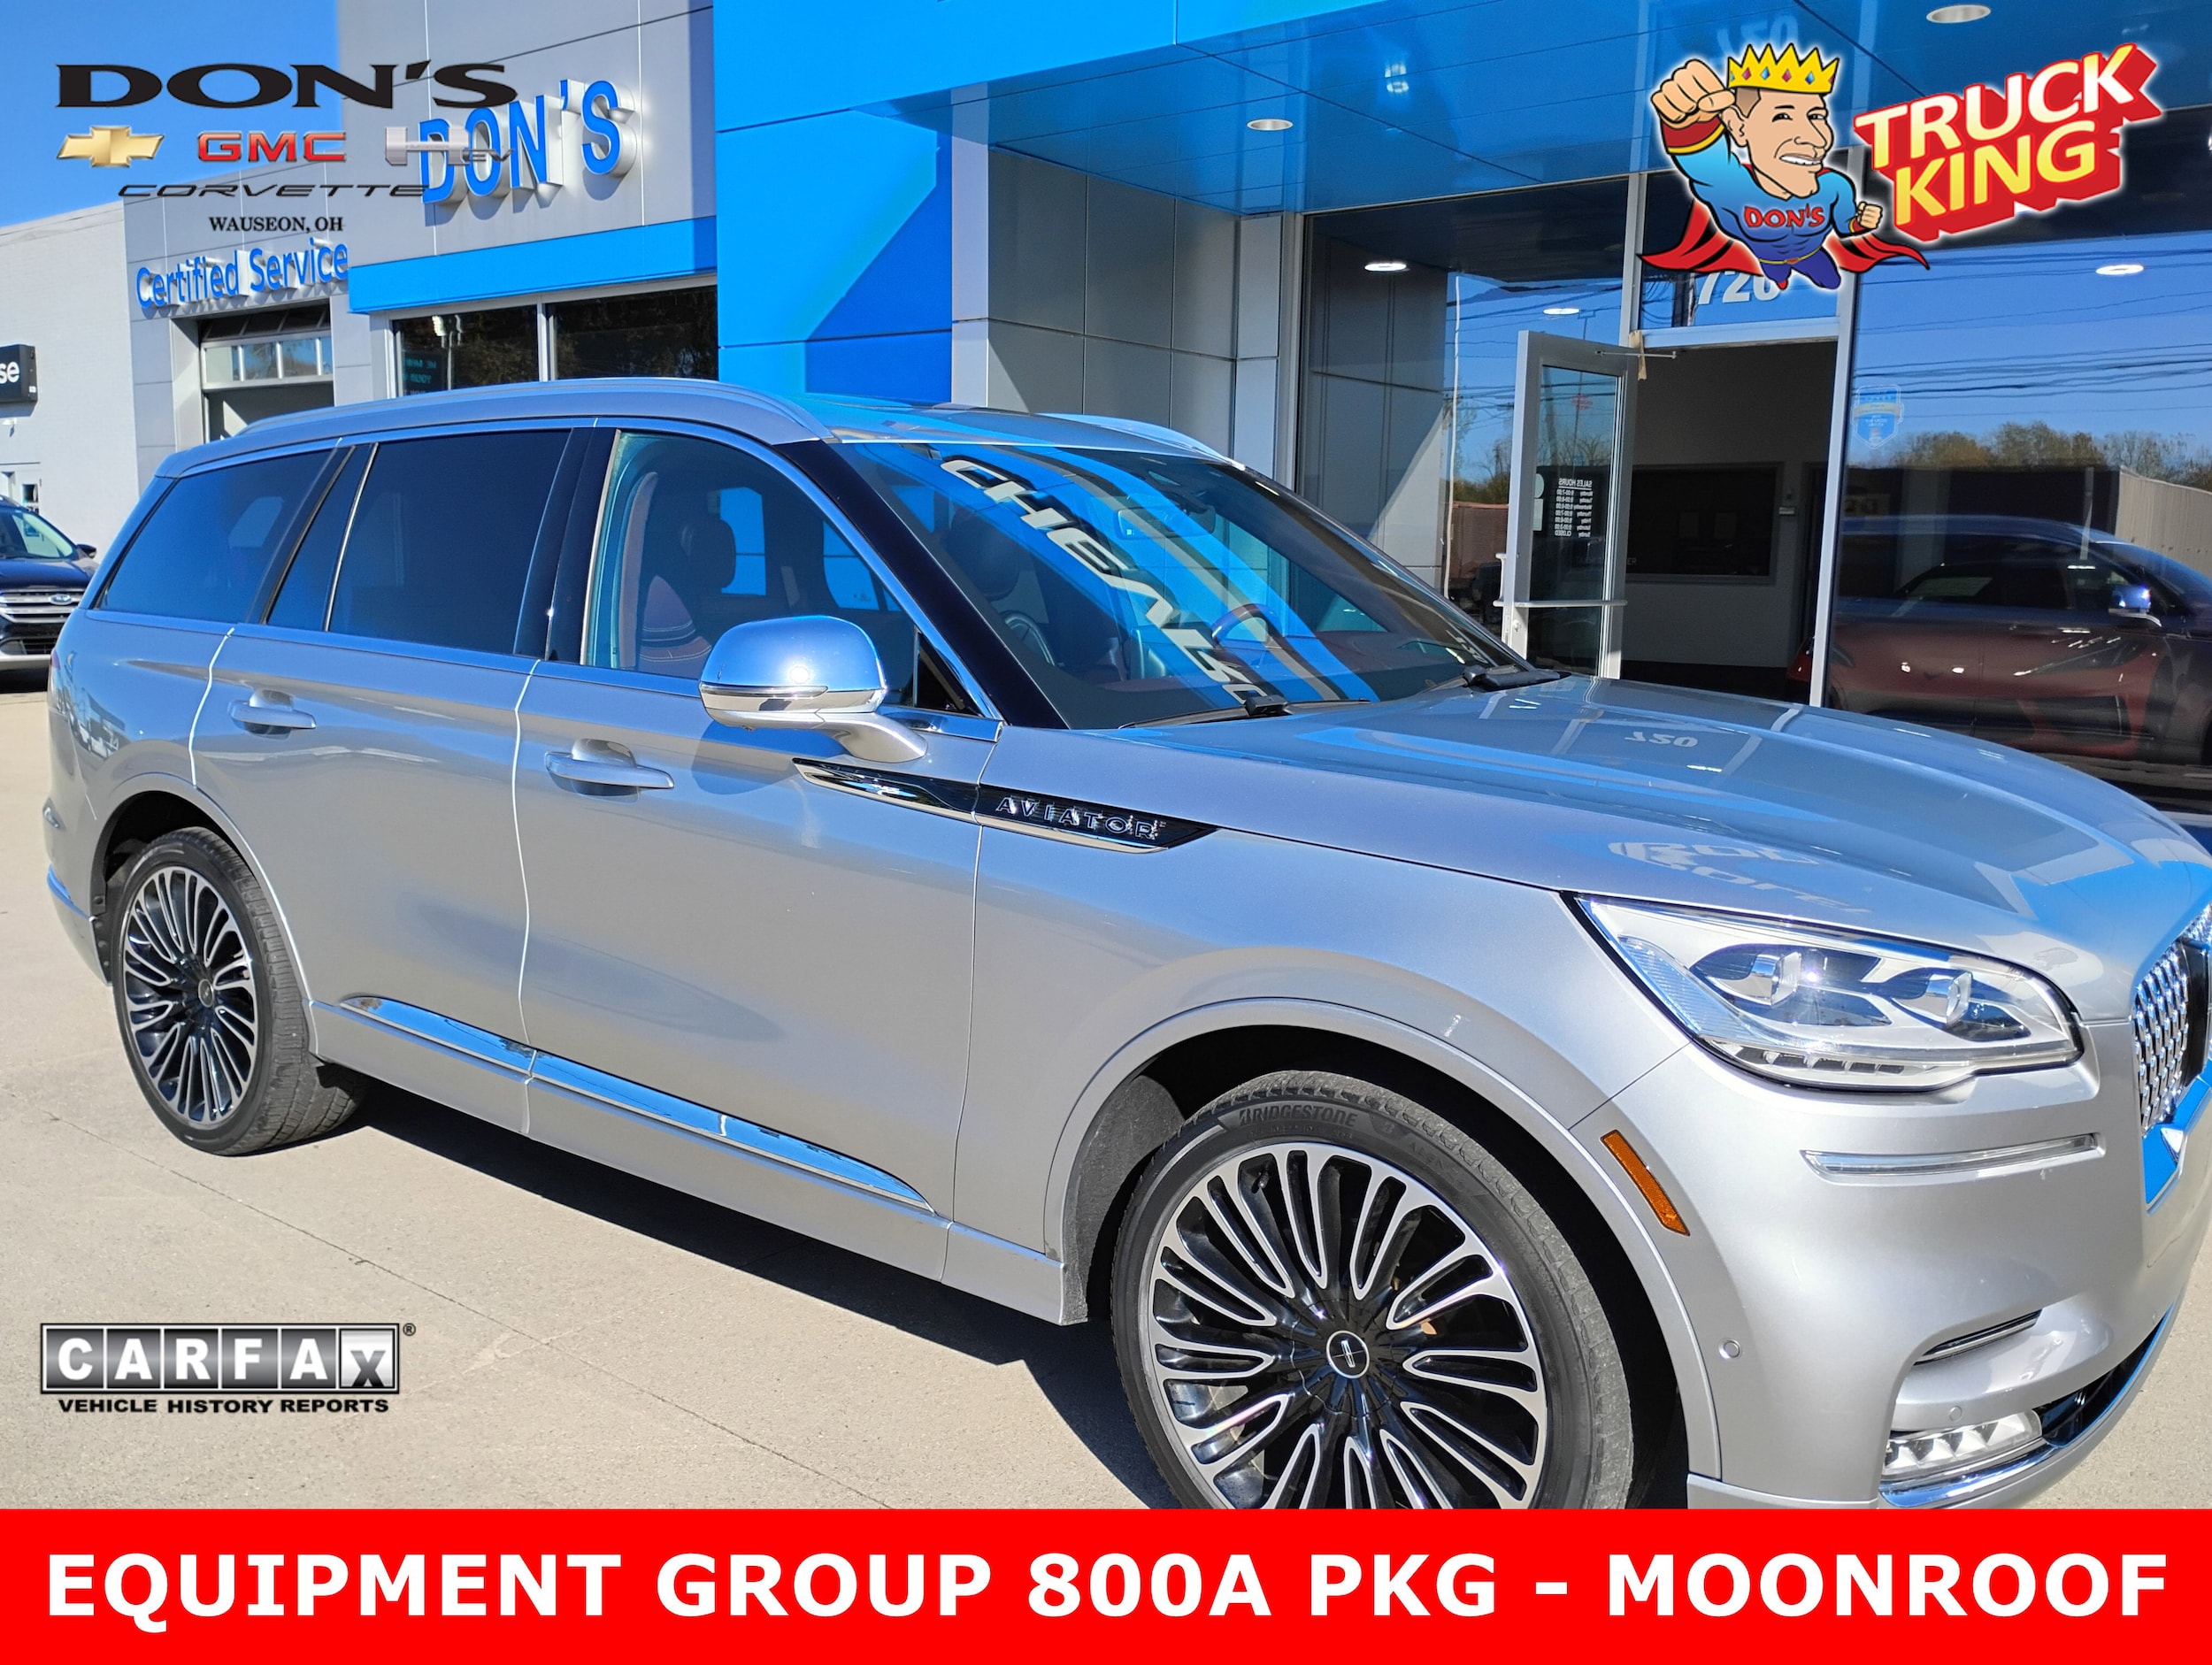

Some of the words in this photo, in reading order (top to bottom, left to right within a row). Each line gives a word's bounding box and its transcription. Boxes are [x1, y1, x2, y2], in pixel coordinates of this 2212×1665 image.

[419, 79, 625, 205] DON'S
[136, 249, 240, 309] Certified
[249, 236, 349, 293] Service
[995, 796, 1158, 840] AVIATOR
[1238, 1103, 1358, 1129] BRIDGESTONE
